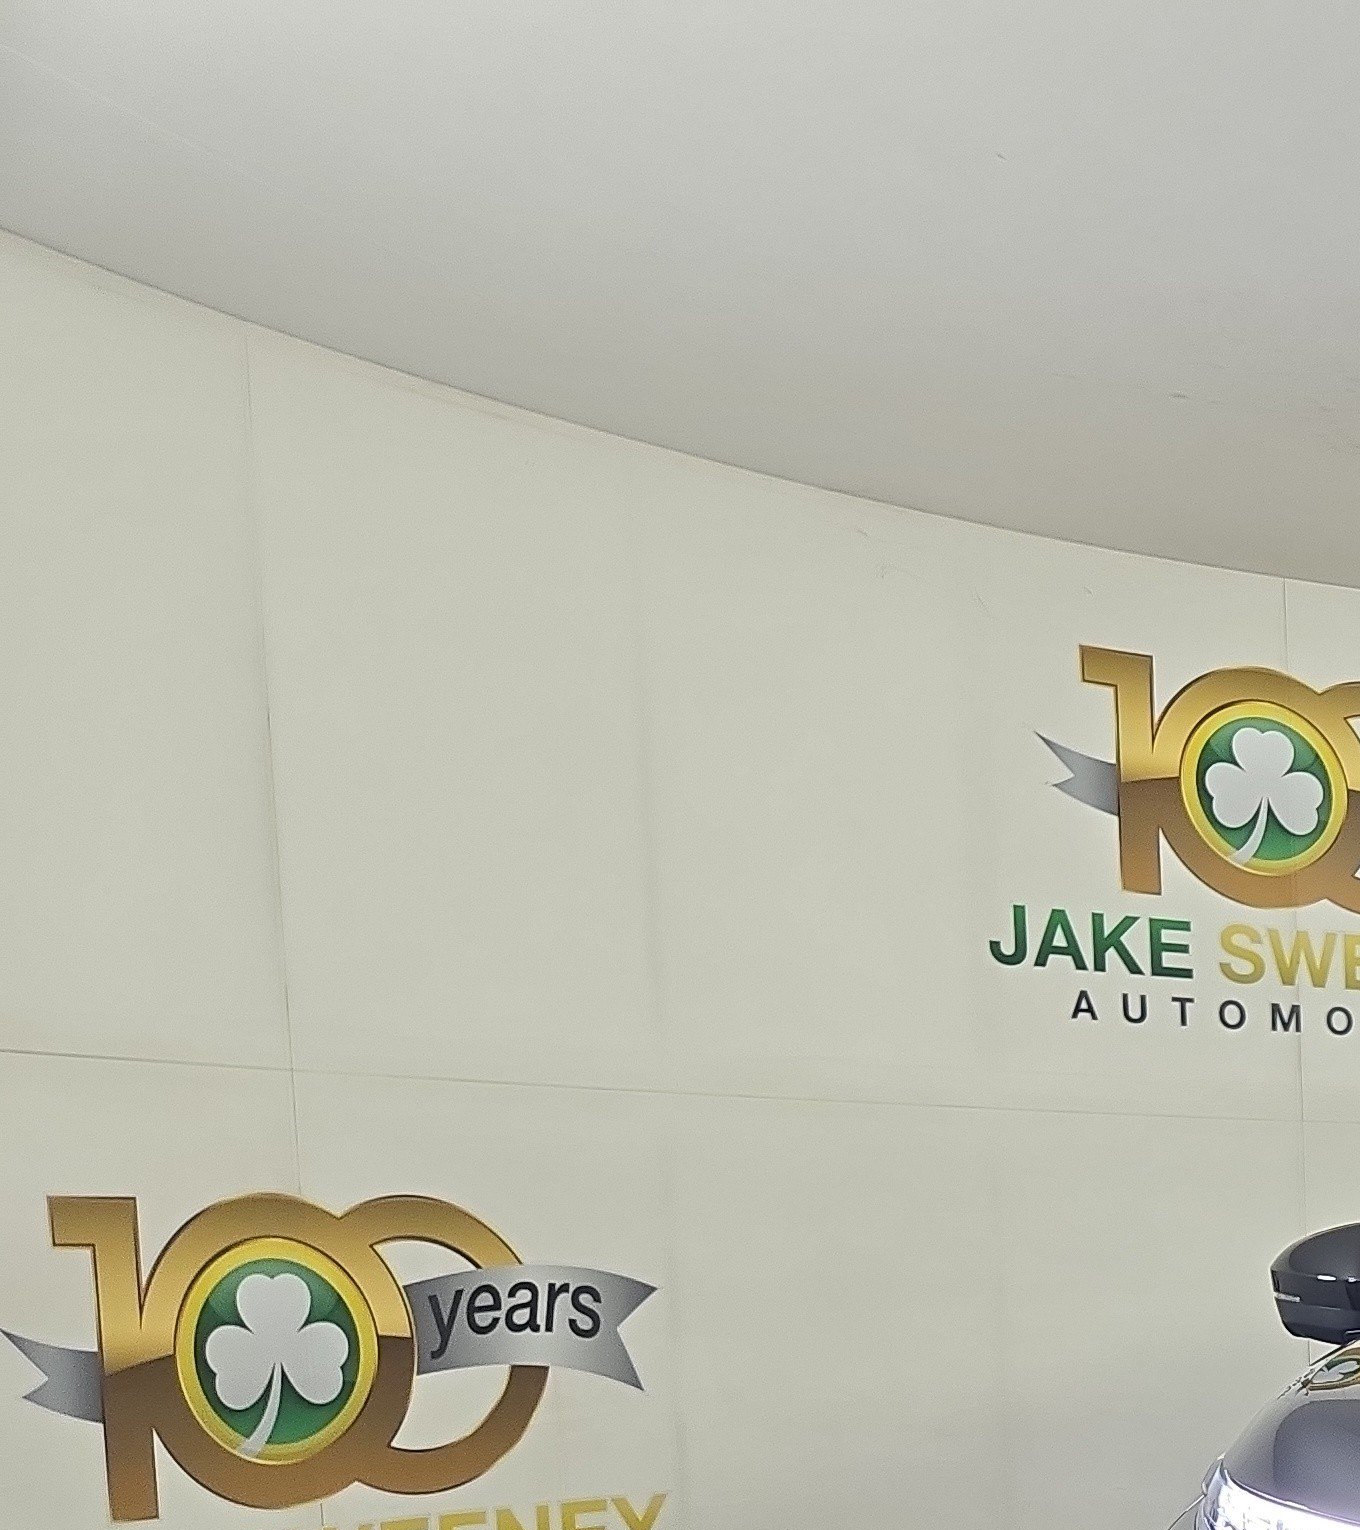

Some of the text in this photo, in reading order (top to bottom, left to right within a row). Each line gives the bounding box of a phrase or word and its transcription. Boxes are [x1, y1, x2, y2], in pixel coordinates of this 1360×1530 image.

[989, 905, 1194, 980] JAKE
[46, 1193, 550, 1523] 100
[429, 1280, 602, 1359] years
